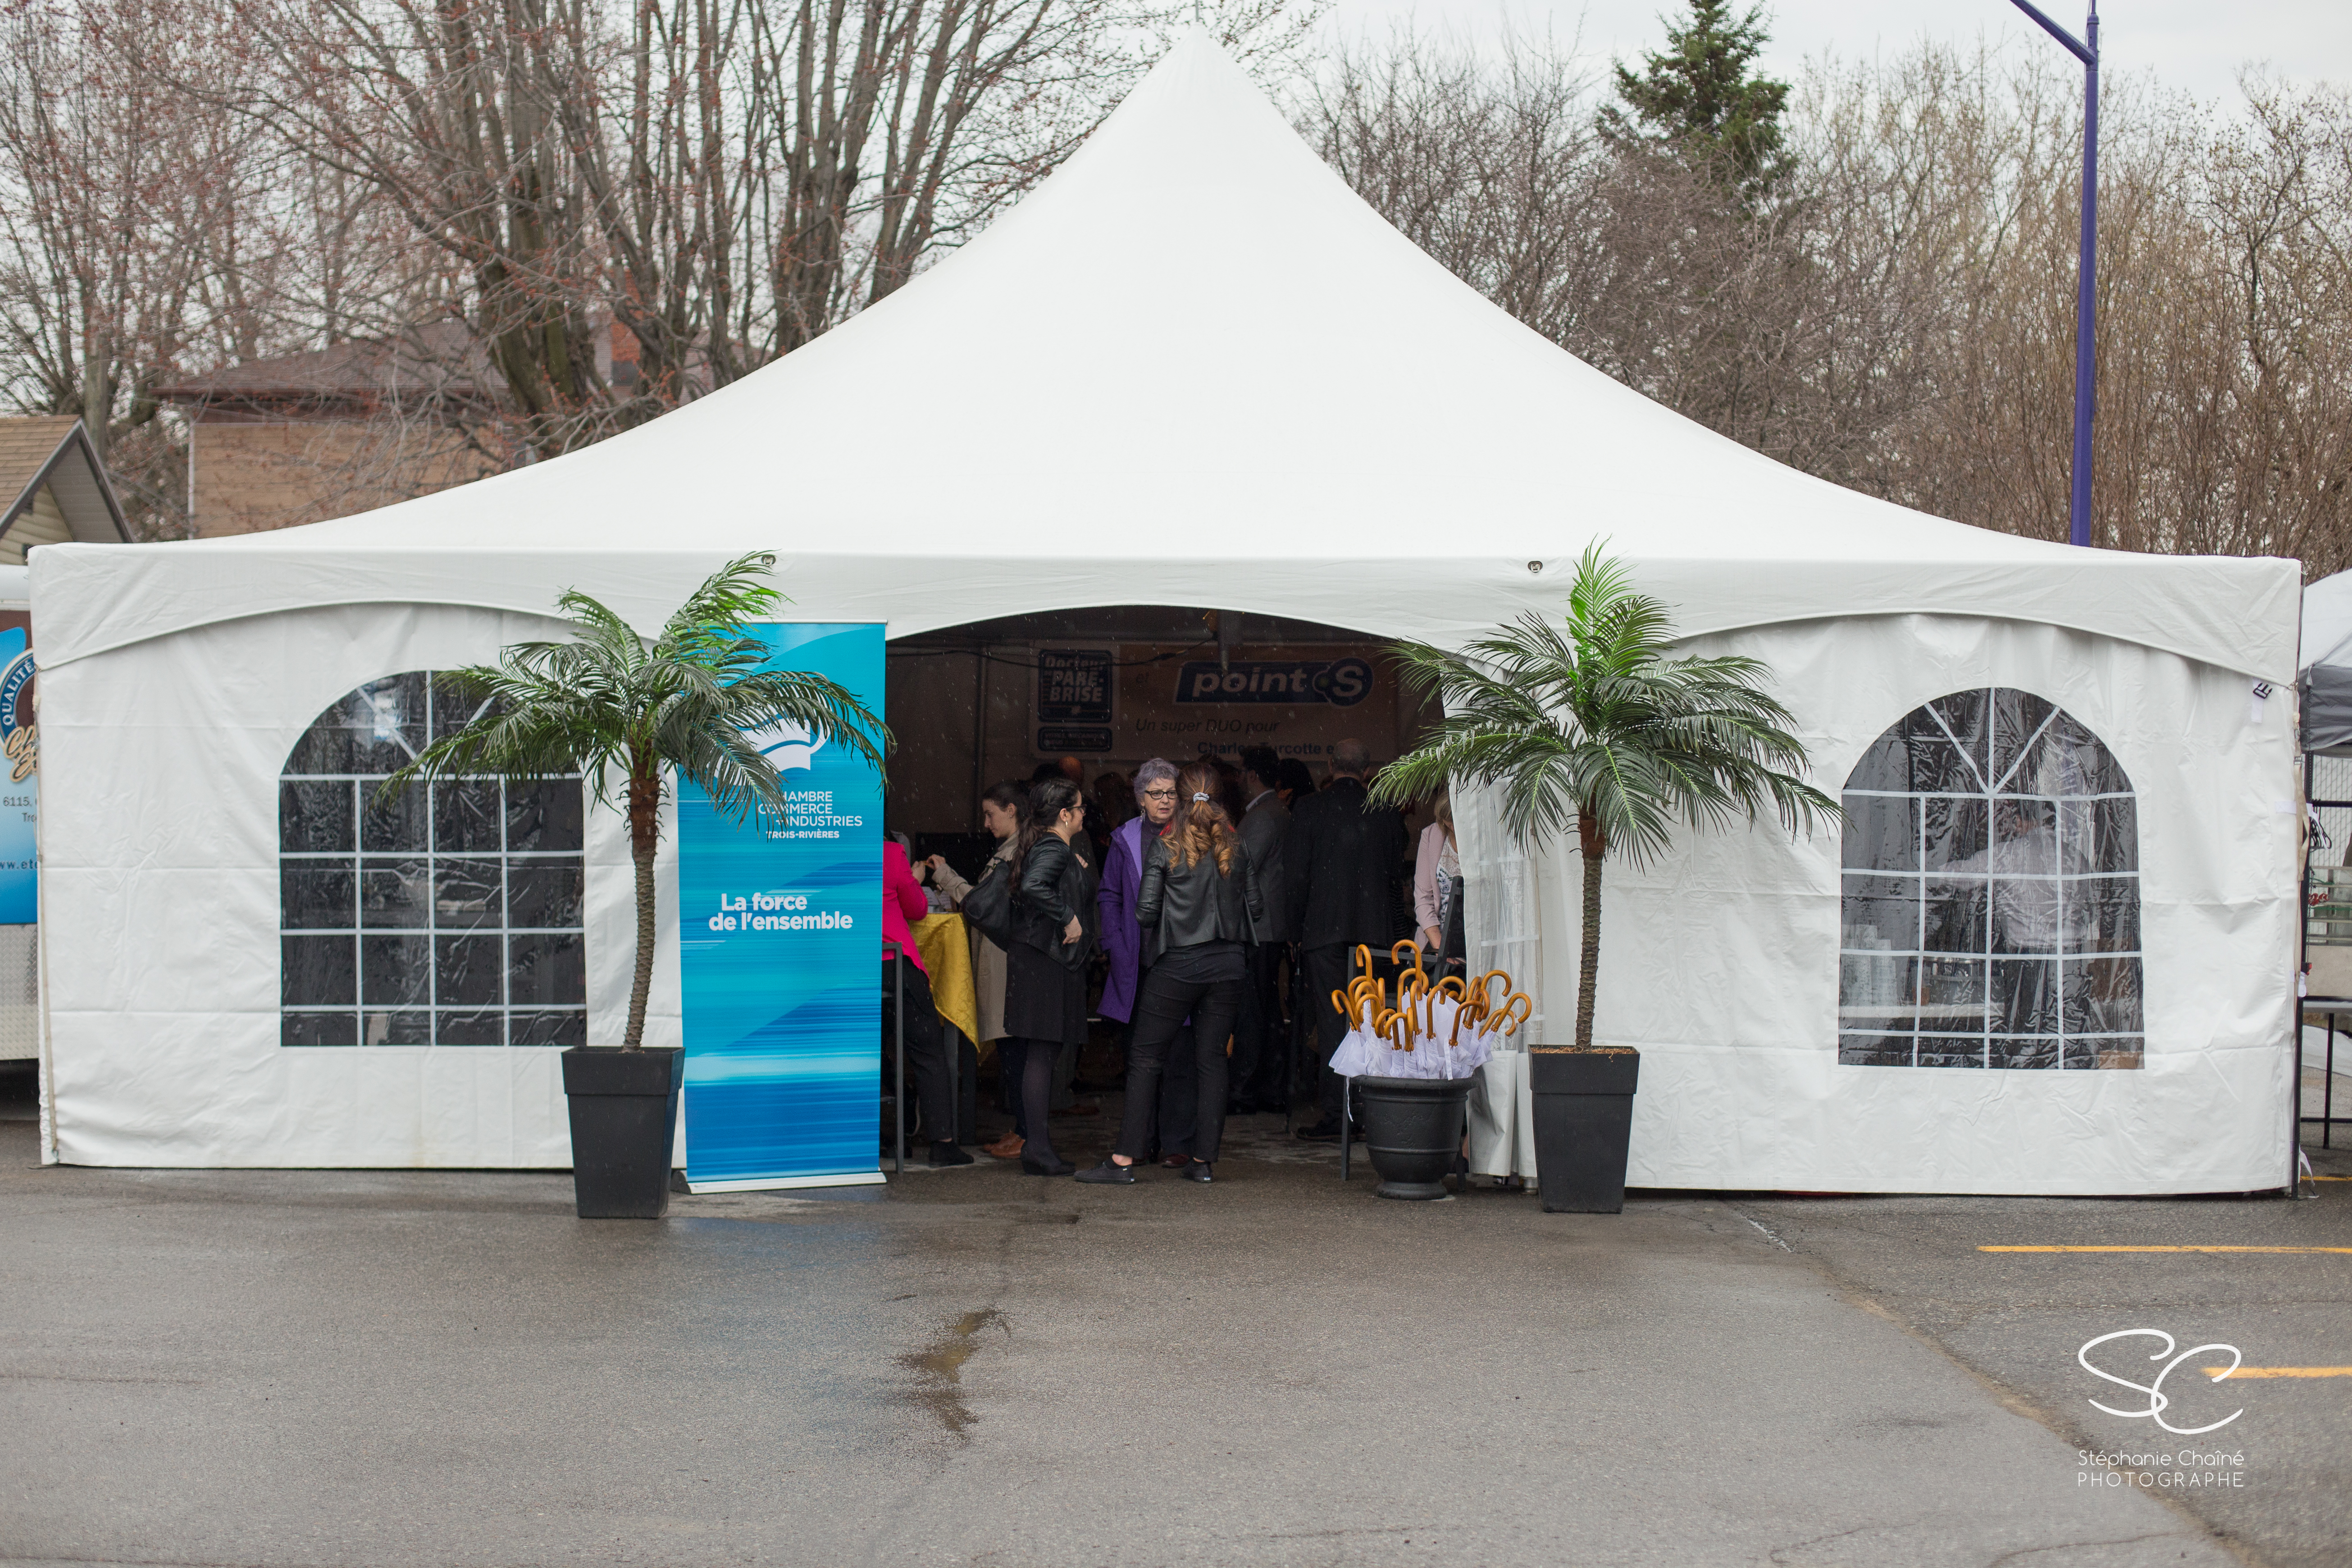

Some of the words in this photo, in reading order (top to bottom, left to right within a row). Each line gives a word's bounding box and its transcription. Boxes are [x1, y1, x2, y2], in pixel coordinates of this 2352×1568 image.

[1052, 670, 1104, 686] PARE-
[1192, 667, 1307, 697] point
[1331, 665, 1364, 697] S
[2, 660, 35, 725] QUALITÉ
[1049, 686, 1103, 702] BRISE
[1136, 718, 1156, 731] Un
[1161, 721, 1202, 734] super
[1206, 719, 1242, 732] DUO
[1245, 720, 1281, 734] pour
[1197, 742, 1253, 754] Charle
[3, 796, 32, 807] 6115,
[766, 828, 840, 839] TROIS-RIVIÈRES
[721, 893, 747, 911] La
[752, 892, 807, 911] force
[708, 912, 737, 931] de
[741, 911, 853, 930] l'ensemble
